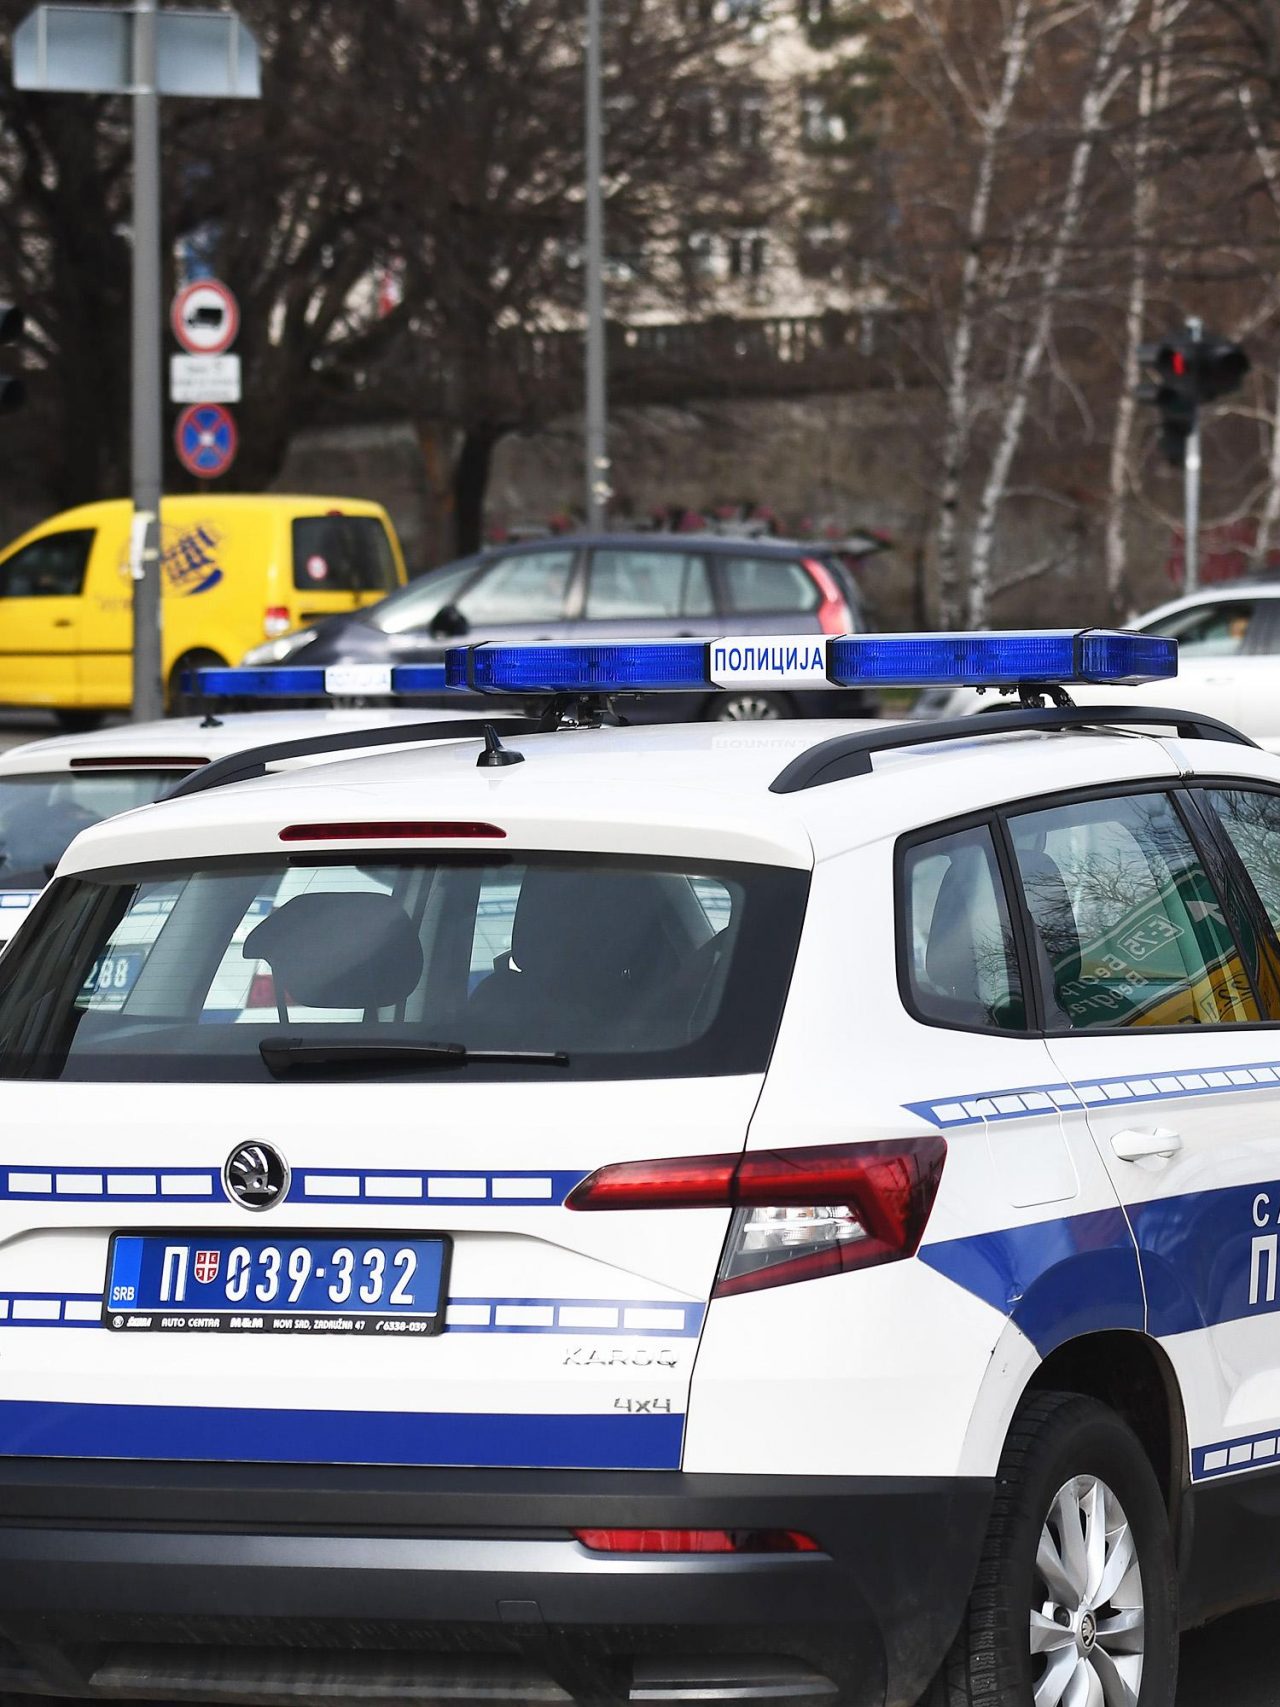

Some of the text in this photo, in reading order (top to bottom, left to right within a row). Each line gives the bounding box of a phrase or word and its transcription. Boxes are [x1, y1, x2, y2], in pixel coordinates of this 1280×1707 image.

[713, 644, 825, 675] ПОЛИЦИЈА
[83, 958, 129, 989] 288
[159, 1245, 190, 1302] П
[112, 1286, 136, 1301] SRB
[161, 1317, 185, 1328] AUTO
[188, 1317, 221, 1328] CENTAR
[272, 1319, 293, 1329] NOVI
[294, 1319, 312, 1330] SAD,
[354, 1321, 366, 1331] 47
[562, 1348, 678, 1368] KAROQ
